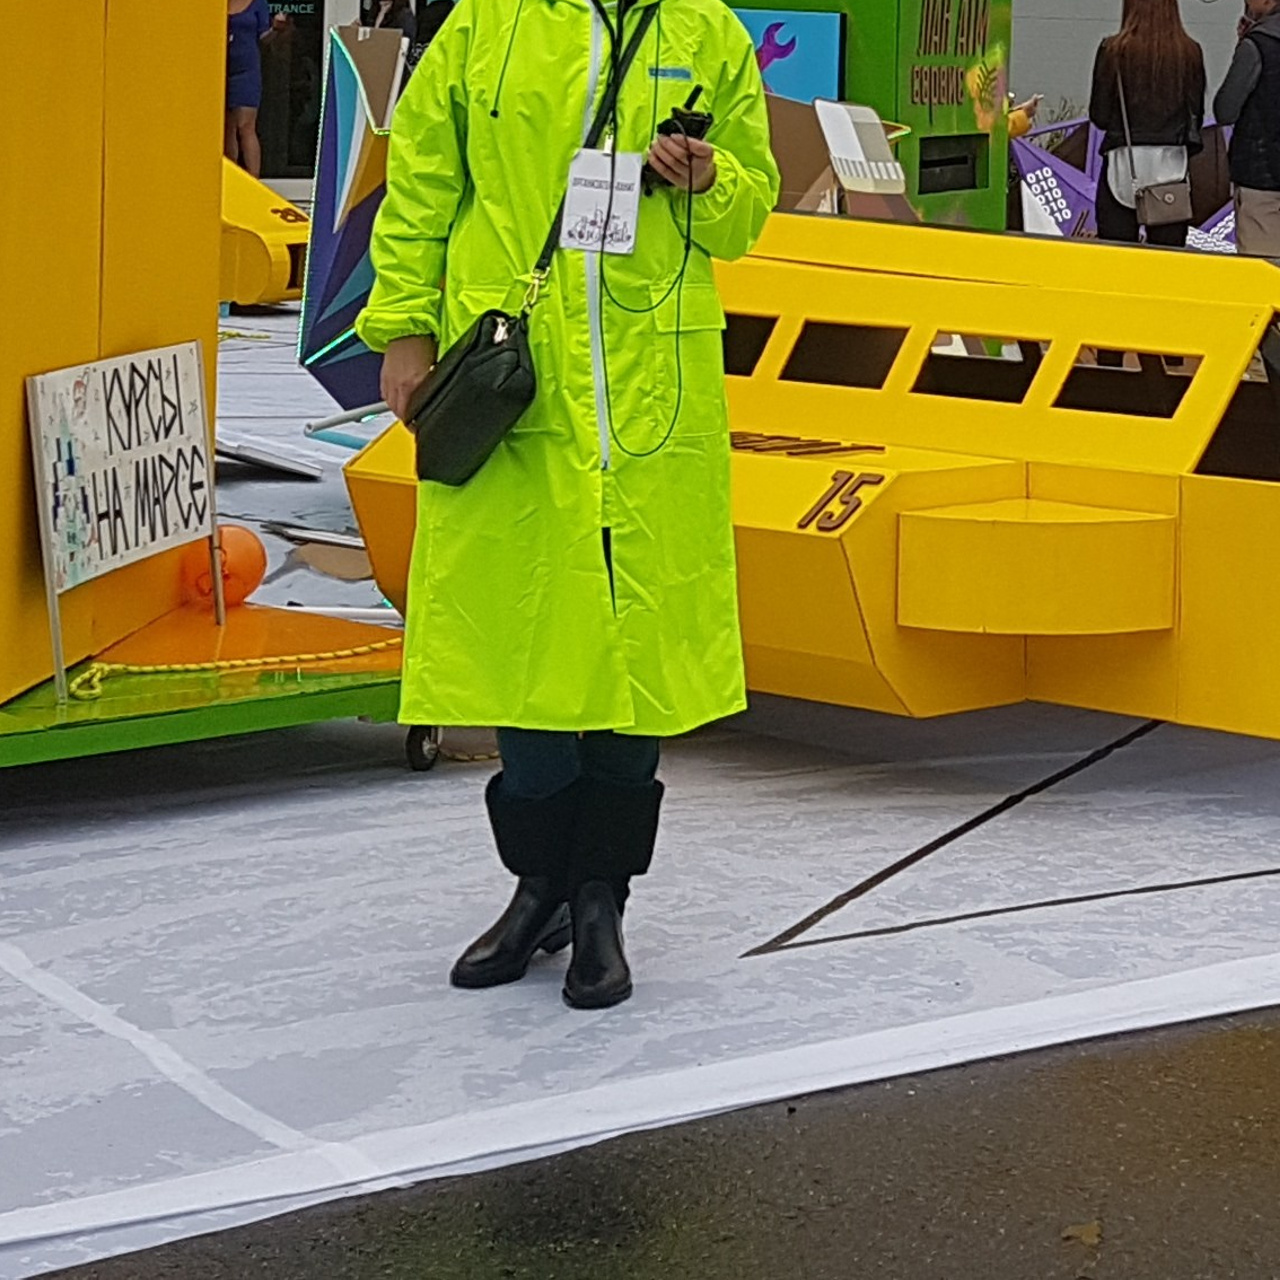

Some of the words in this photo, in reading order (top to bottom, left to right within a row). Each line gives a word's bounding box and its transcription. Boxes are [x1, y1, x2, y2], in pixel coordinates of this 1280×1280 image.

[268, 3, 315, 14] TRANCE
[102, 354, 184, 456] КУРСЫ
[92, 466, 130, 561] НА
[134, 445, 207, 548] МАРСЕ
[797, 470, 885, 532] 15
